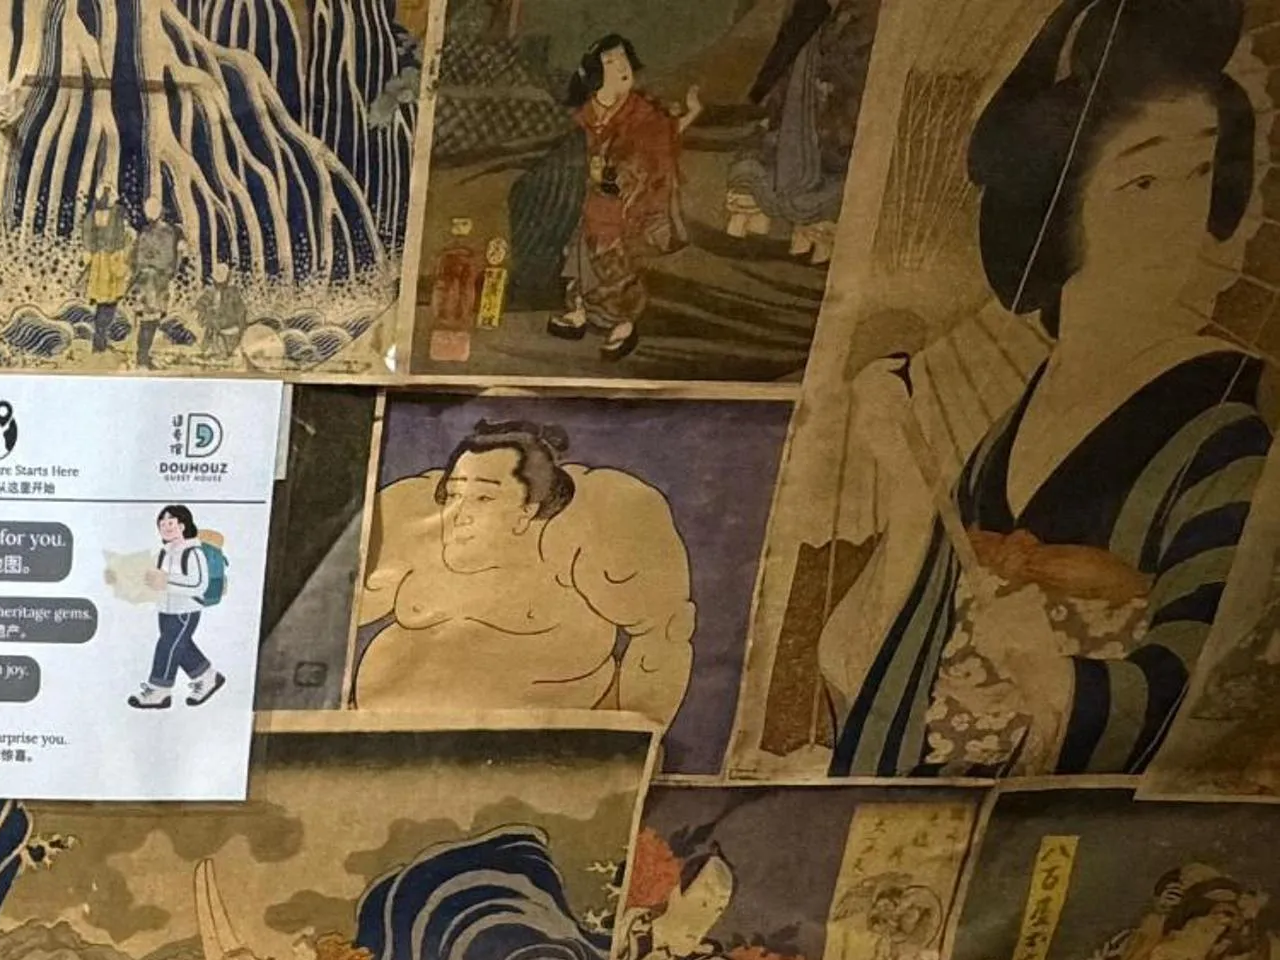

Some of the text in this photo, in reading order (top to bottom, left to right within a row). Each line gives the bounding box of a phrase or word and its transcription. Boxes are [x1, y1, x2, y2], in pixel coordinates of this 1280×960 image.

[15, 464, 48, 477] Starts
[51, 465, 80, 477] Here
[159, 462, 228, 474] DOUHOUZ
[0, 527, 26, 545] for
[29, 532, 67, 550] you.
[54, 607, 92, 623] gems.
[4, 661, 29, 679] joy.
[41, 735, 68, 748] you.
